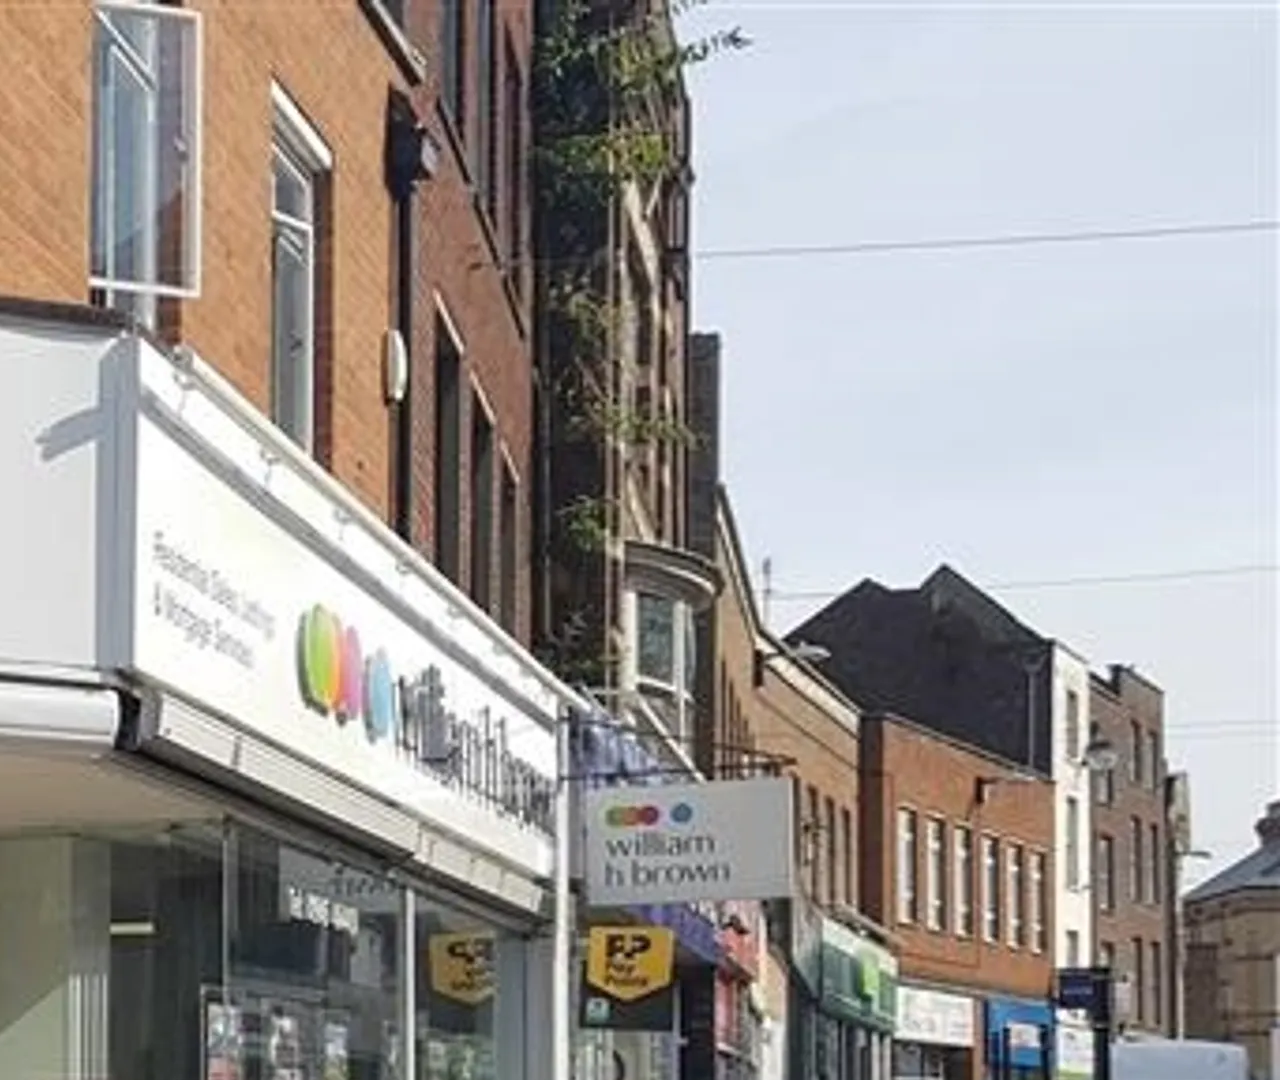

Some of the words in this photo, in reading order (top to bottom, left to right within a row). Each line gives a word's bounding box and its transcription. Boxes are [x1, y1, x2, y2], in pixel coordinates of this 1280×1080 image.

[604, 833, 716, 858] william
[604, 863, 624, 888] h
[632, 860, 731, 887] brown
